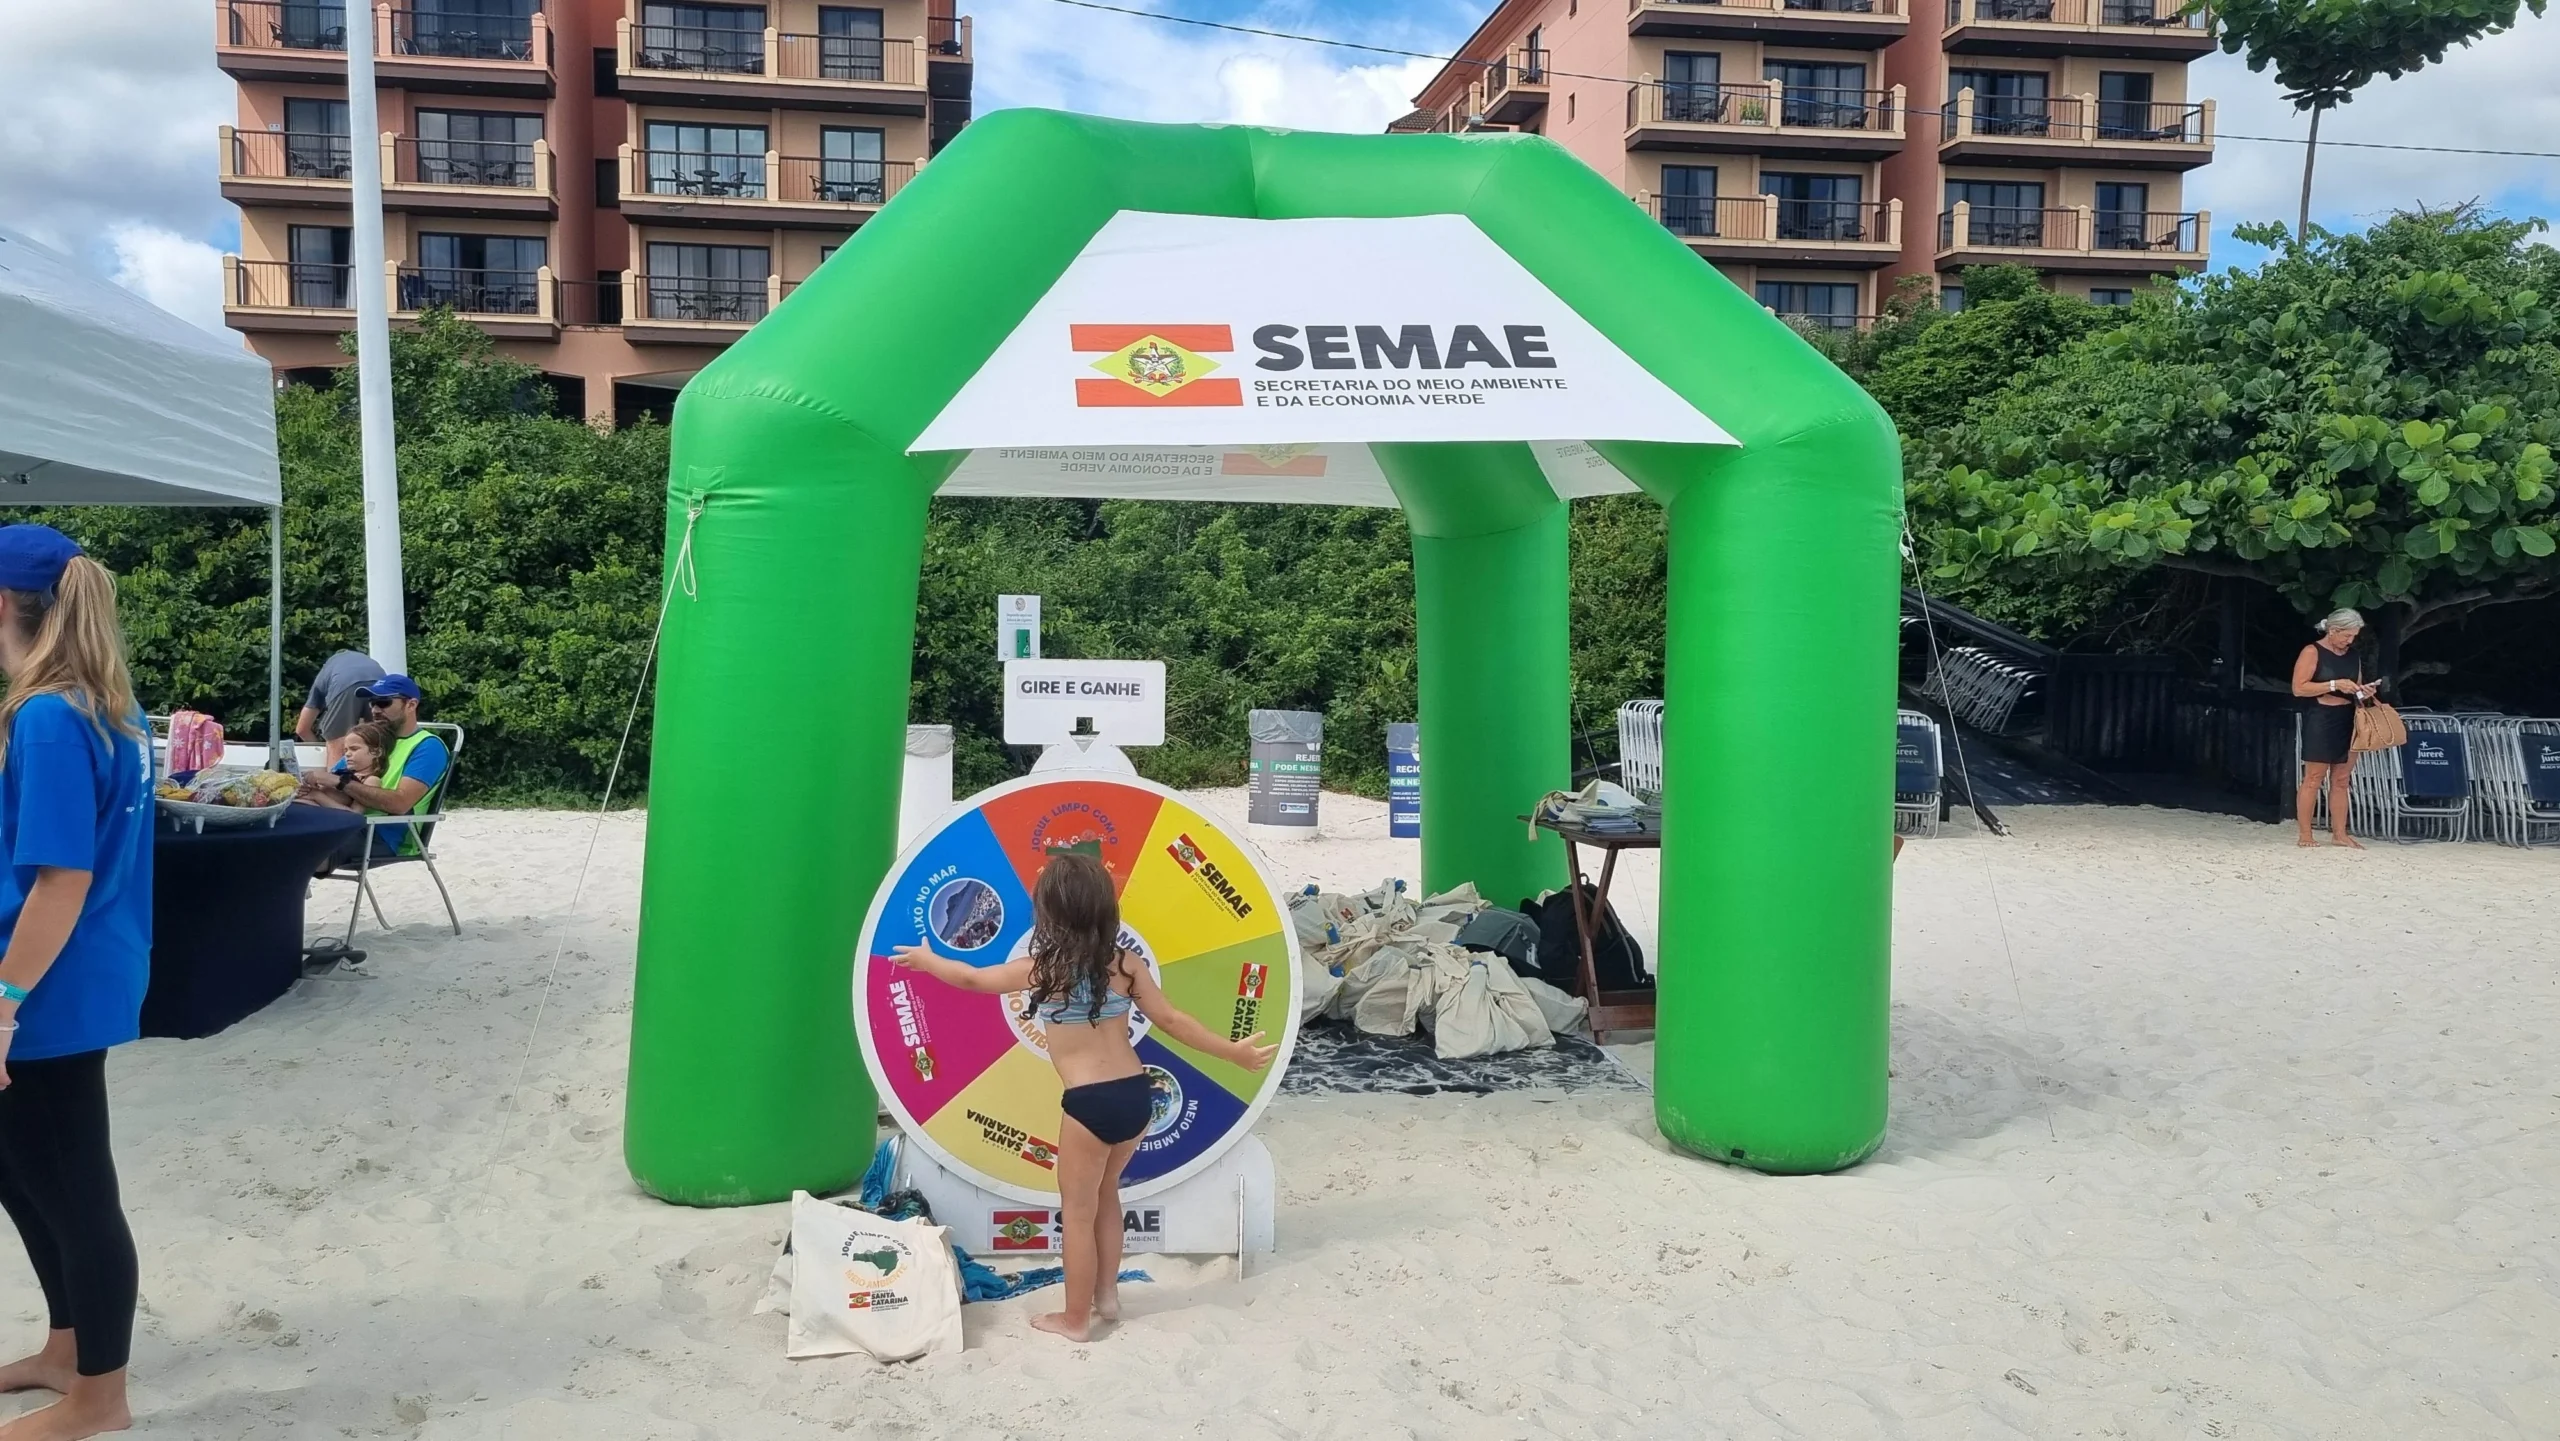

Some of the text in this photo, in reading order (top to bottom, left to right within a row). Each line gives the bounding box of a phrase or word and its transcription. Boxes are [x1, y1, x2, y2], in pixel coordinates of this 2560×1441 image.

[1253, 324, 1557, 371] SEMAE
[1254, 379, 1568, 391] SECRETARIA DO MEIO AMBIENTE
[1257, 394, 1485, 406] E DA ECONOMIA VERDE
[1021, 680, 1140, 696] GIRE E GANHE
[1032, 802, 1118, 852] JOGUE LIMPO COM O
[914, 865, 957, 935] LIXO NO MAR
[1200, 862, 1252, 918] SEMAE
[890, 981, 920, 1047] SEMAE
[1230, 998, 1246, 1042] CATARI
[1240, 1000, 1257, 1039] SANTA
[966, 1109, 1027, 1142] CATARINA
[1180, 1100, 1199, 1130] MEIO
[983, 1128, 1023, 1152] SANTA
[842, 1230, 859, 1257] JOGUE
[845, 1264, 908, 1288] MEIO AMBIENTE
[871, 1296, 908, 1306] CATARINA
